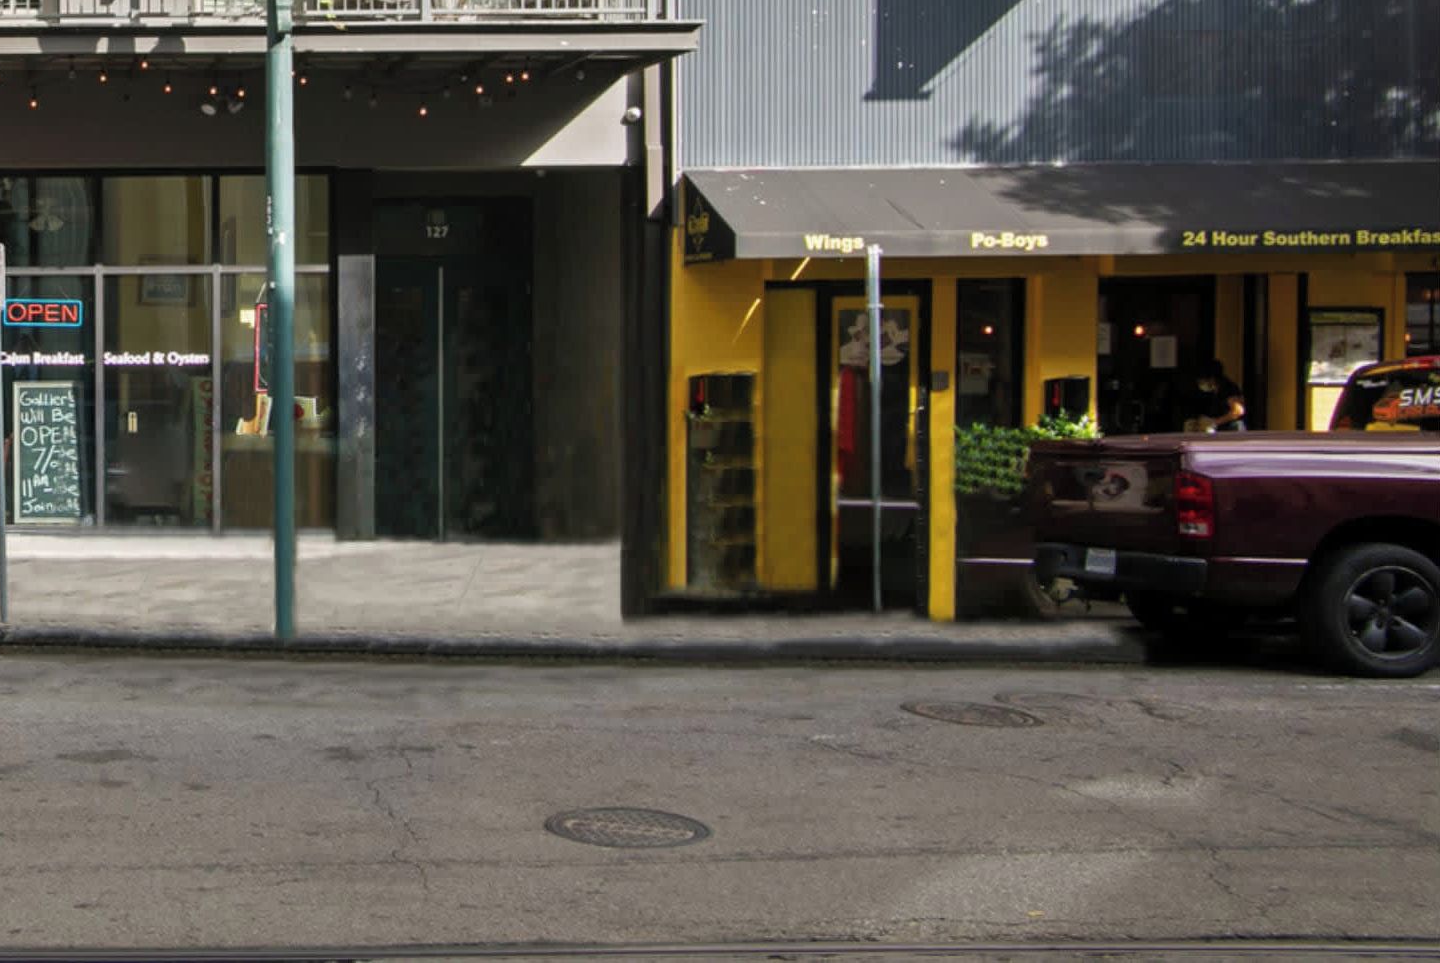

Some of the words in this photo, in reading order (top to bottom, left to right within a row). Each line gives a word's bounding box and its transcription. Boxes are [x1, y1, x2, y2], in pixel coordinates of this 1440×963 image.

[426, 225, 449, 238] 127
[1182, 231, 1207, 247] 24
[1212, 231, 1258, 246] Hour
[1263, 230, 1351, 246] Southern
[805, 234, 865, 253] Wings
[971, 232, 1049, 251] Po-Boys
[7, 303, 78, 323] OPEN
[33, 351, 86, 366] Breakfast
[103, 351, 150, 366] Seafood
[152, 352, 165, 365] &
[51, 408, 77, 424] Be
